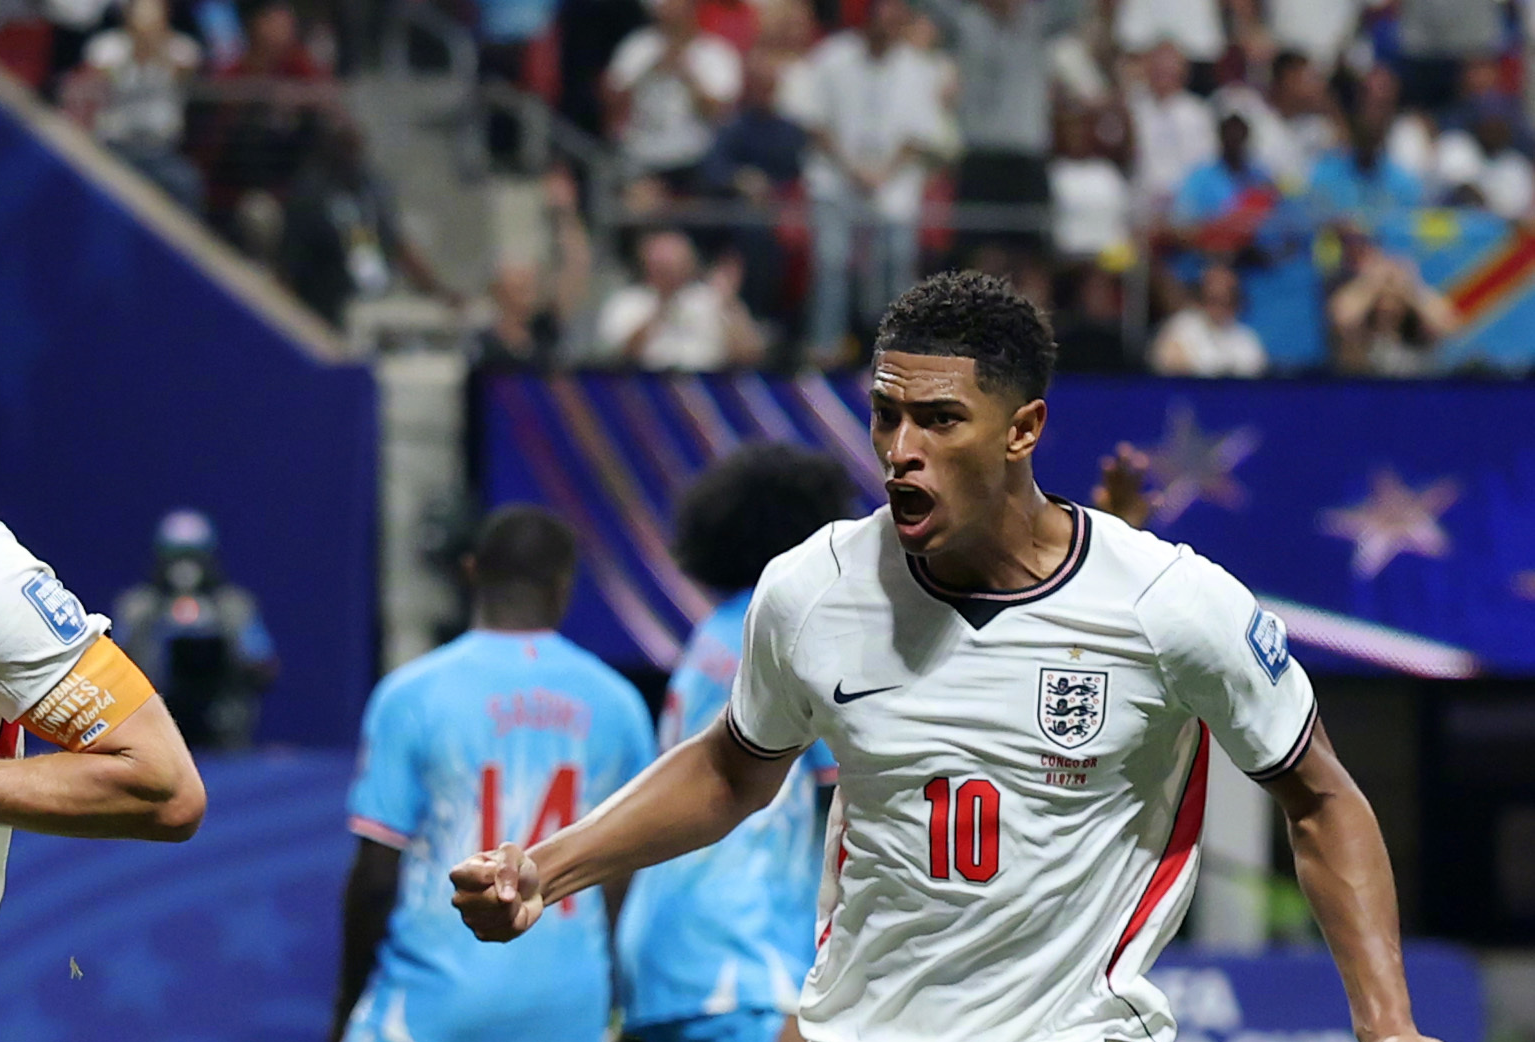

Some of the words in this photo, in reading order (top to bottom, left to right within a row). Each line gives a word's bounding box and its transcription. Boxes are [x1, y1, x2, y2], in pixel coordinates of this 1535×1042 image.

[28, 671, 87, 725] FOOTBALL
[38, 680, 100, 735] UNITES
[72, 689, 117, 731] World
[82, 722, 106, 742] FIFA
[1040, 754, 1080, 769] CONGO
[479, 763, 579, 918] 14
[924, 776, 1000, 883] 10
